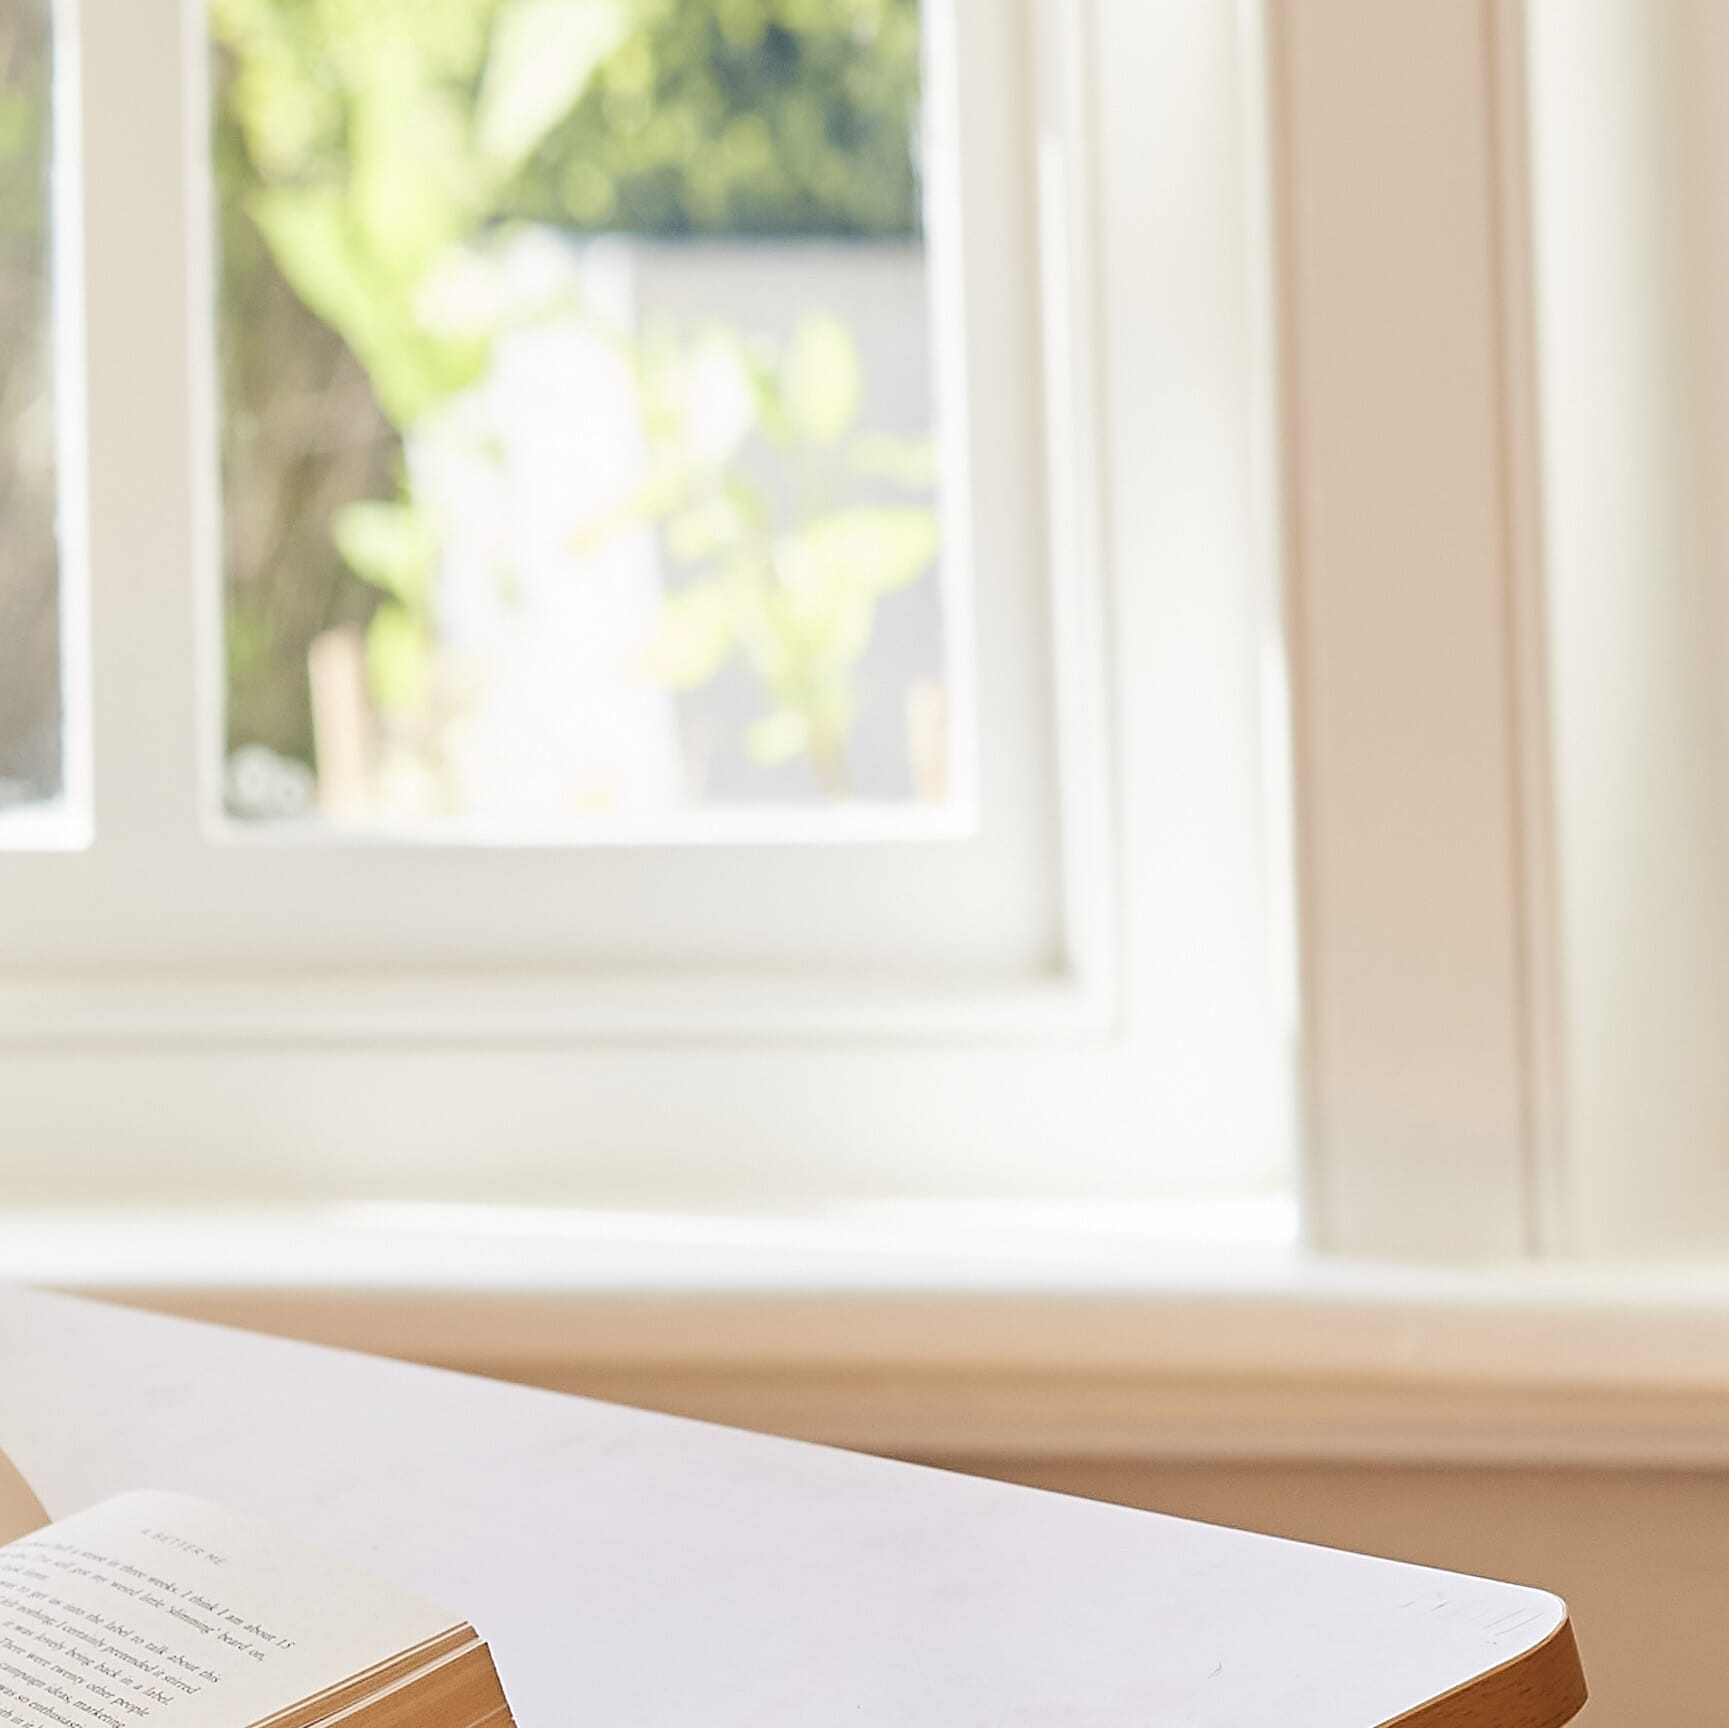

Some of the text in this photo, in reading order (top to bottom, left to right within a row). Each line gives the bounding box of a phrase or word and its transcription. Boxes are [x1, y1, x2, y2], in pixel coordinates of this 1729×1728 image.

[152, 1530, 207, 1557] BETTER
[206, 1551, 229, 1567] ME
[217, 1632, 252, 1650] beard
[243, 1624, 276, 1640] about
[101, 1646, 158, 1671] pretended
[162, 1676, 200, 1694] stirred
[167, 1655, 220, 1682] about this
[86, 1684, 148, 1716] other people
[73, 1701, 124, 1728] marketing
